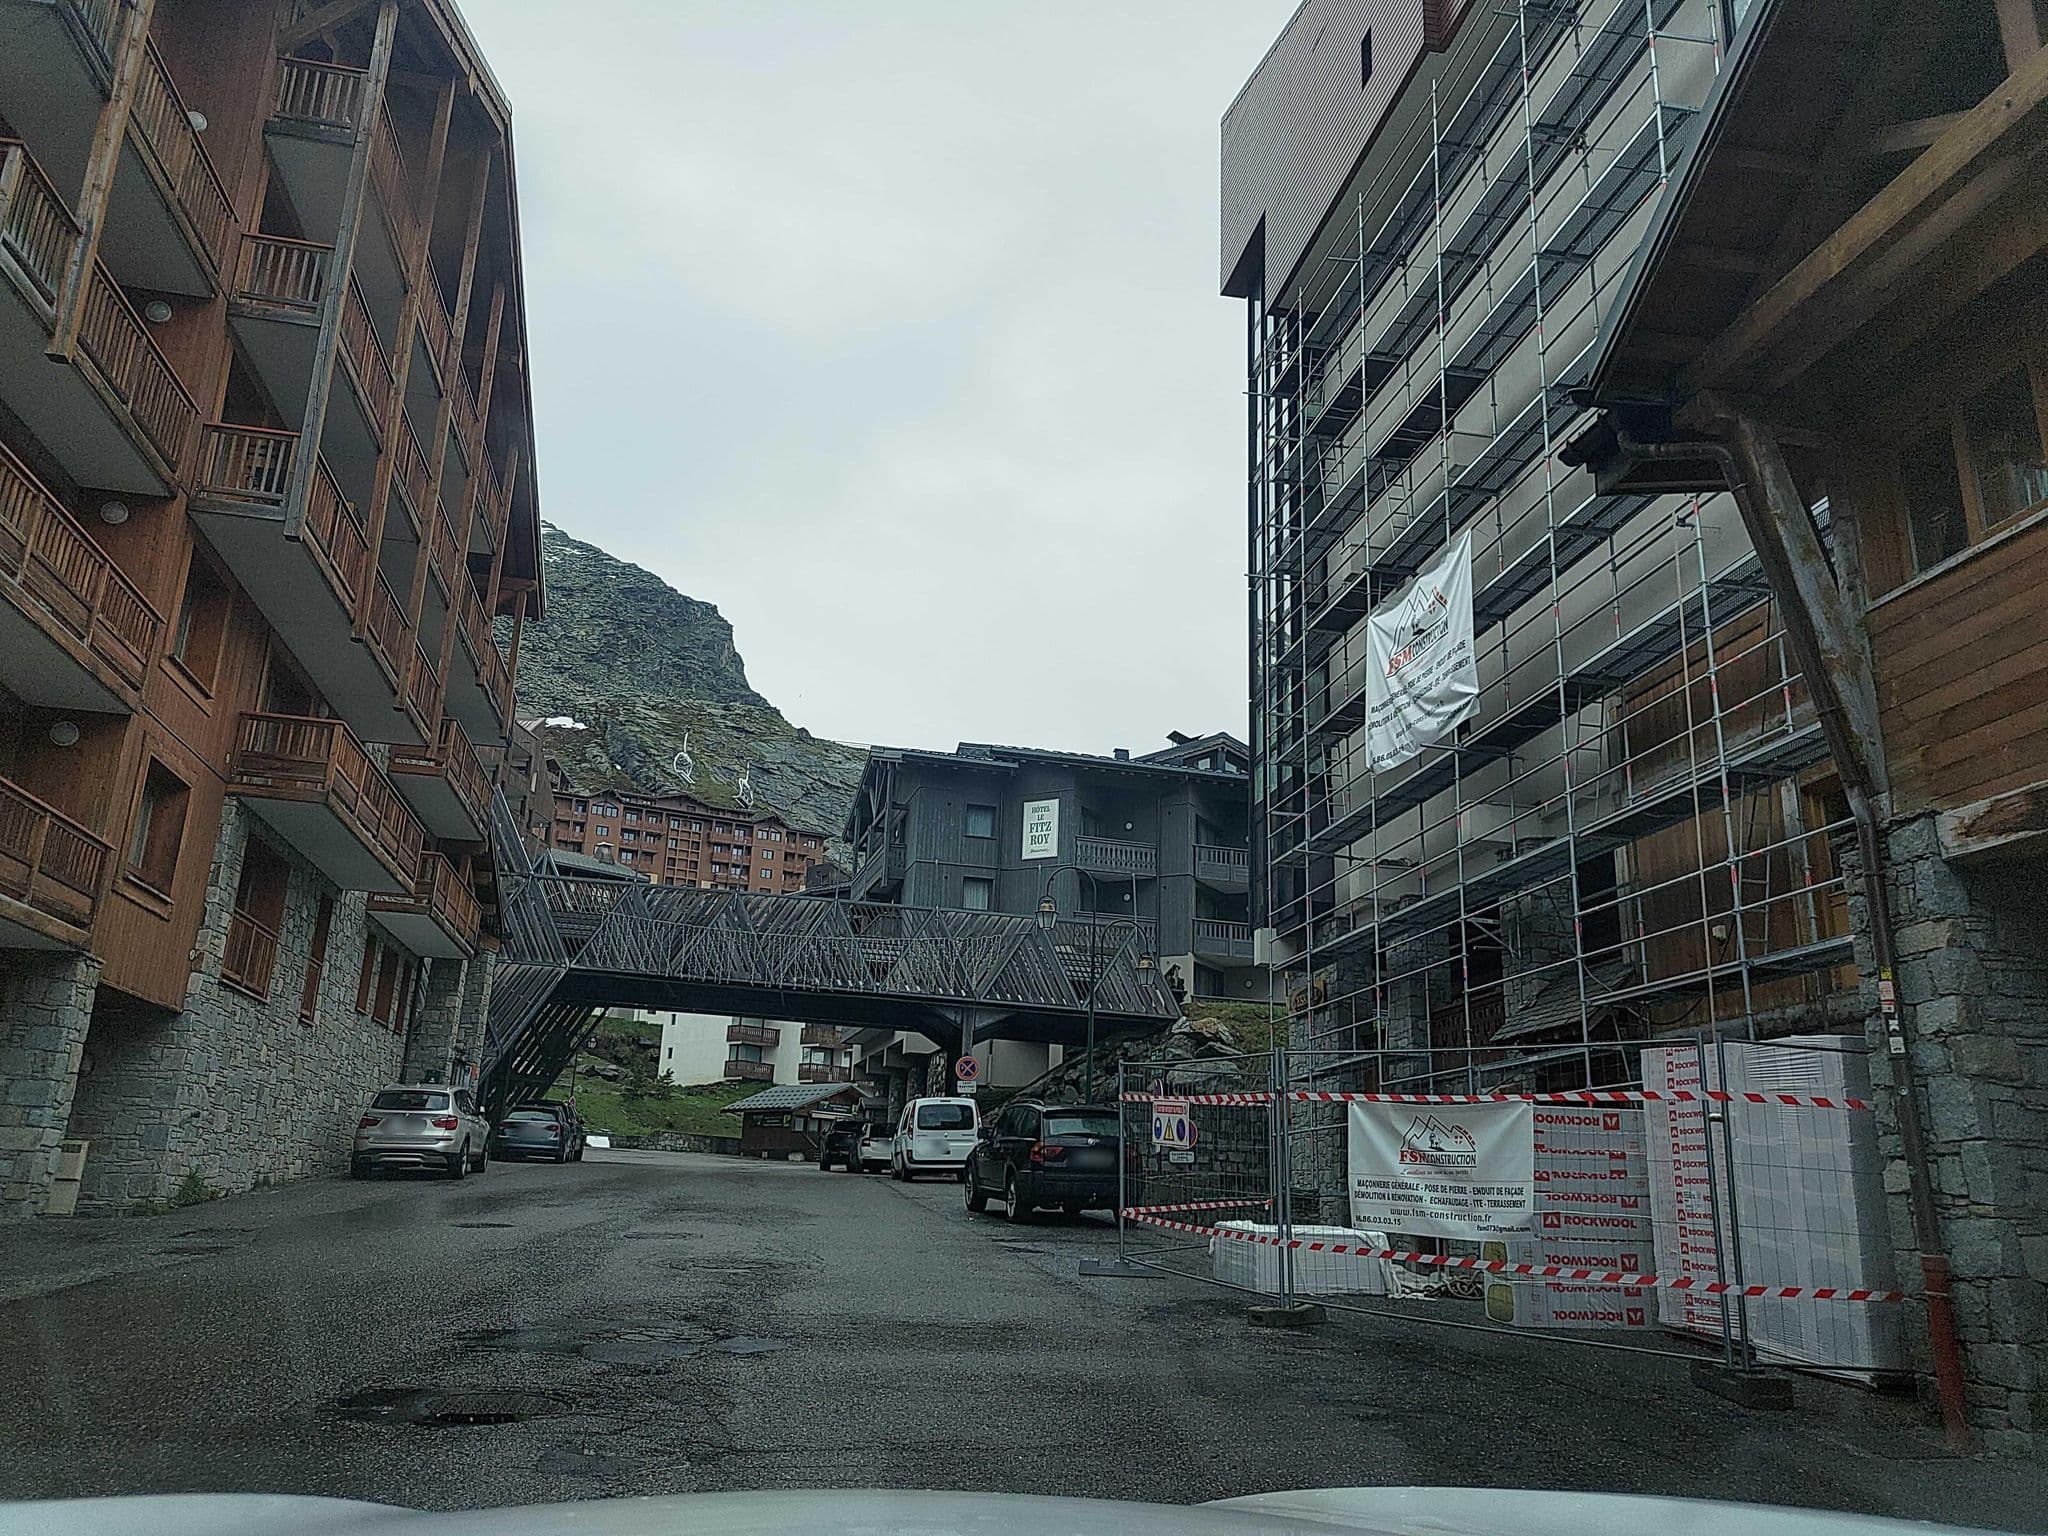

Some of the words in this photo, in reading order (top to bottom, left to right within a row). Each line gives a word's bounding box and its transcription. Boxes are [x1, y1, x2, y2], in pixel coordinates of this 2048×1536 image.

[1029, 821, 1052, 833] FITZ
[1030, 834, 1050, 845] ROY
[1675, 1061, 1699, 1069] ROCKWO
[1676, 1078, 1701, 1086] ROCKWO
[1357, 1179, 1391, 1189] MAÇONNERIE
[1424, 1183, 1439, 1193] POSE
[1440, 1185, 1448, 1193] DE
[1449, 1185, 1467, 1194] PIERRE
[1472, 1187, 1495, 1195] ENDUIT
[1496, 1187, 1503, 1195] DE
[1504, 1187, 1524, 1198] FAÇADE
[1354, 1190, 1385, 1200] DÉMOLITION
[1487, 1199, 1526, 1209] TERRASSEMENT
[1390, 1207, 1492, 1222] www.fsm-construction.fr
[1564, 1215, 1637, 1229] ROCKWOOL
[1545, 1254, 1618, 1267] ROCKWOOL
[1553, 1310, 1624, 1321] ROCKWOOL
